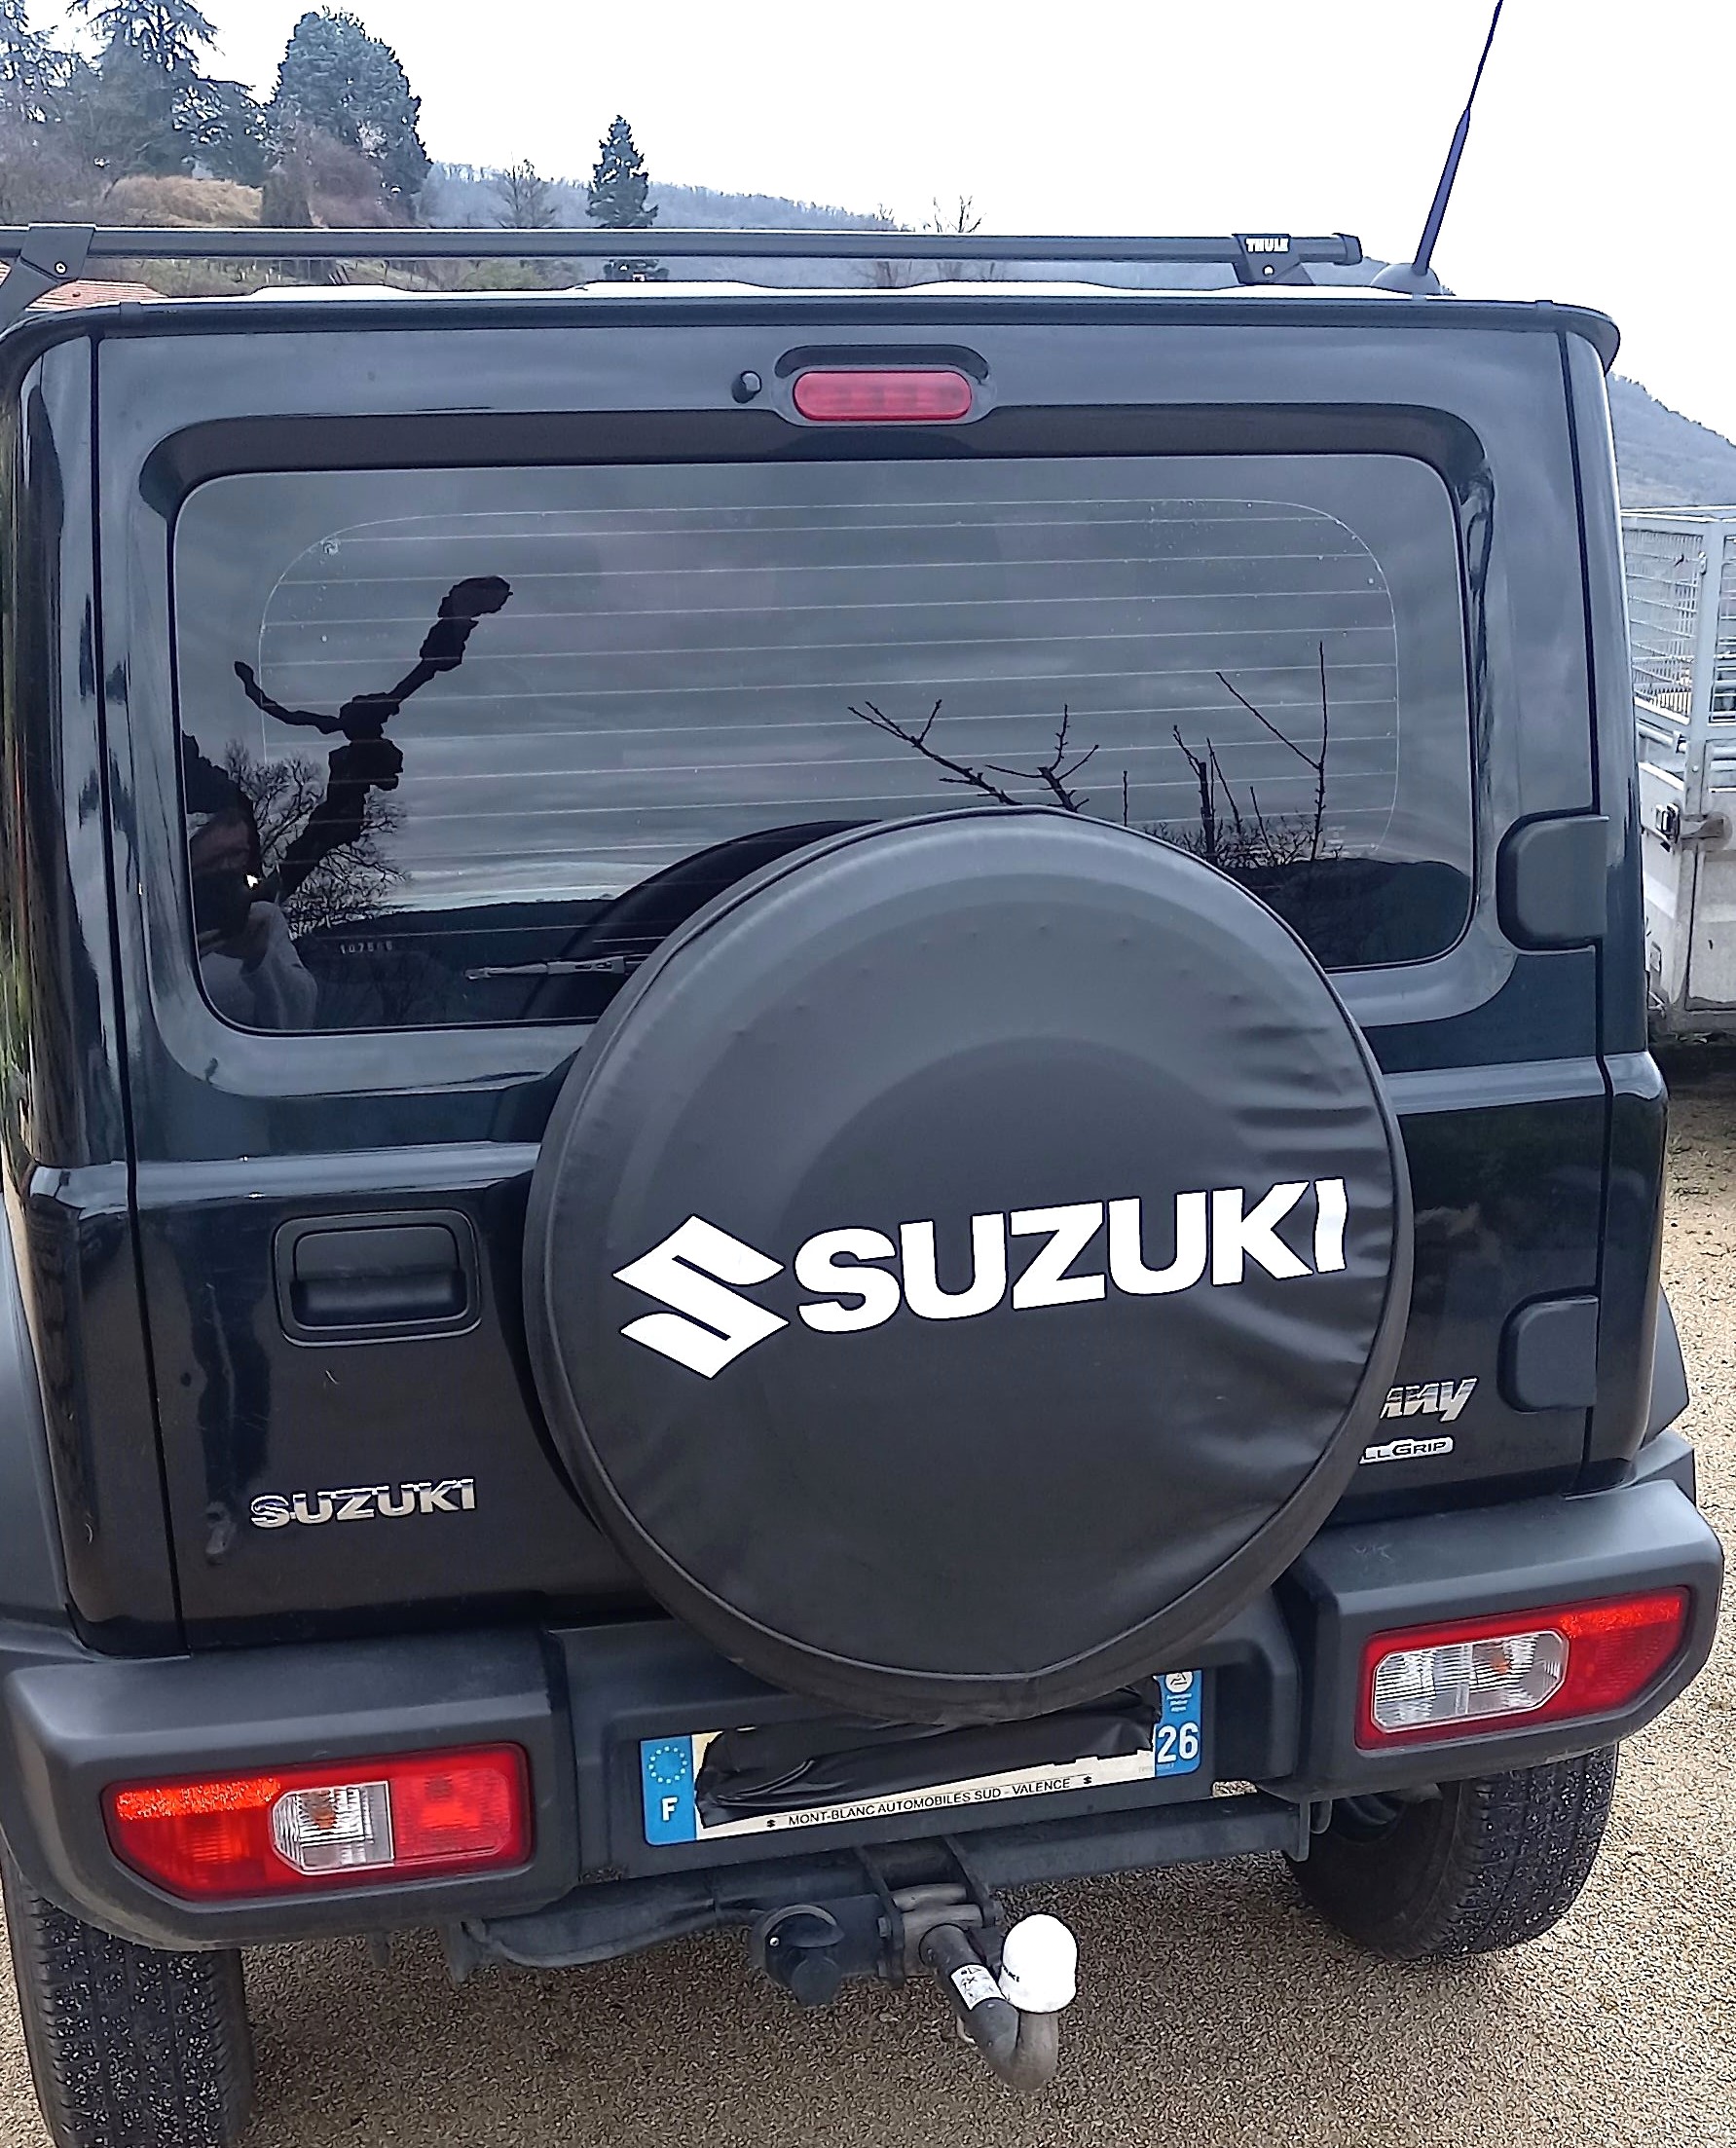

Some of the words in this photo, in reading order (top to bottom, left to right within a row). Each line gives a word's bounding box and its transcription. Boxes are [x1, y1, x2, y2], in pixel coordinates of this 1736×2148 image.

[1245, 238, 1289, 252] THULE
[794, 1177, 1347, 1334] SUZUKI
[250, 1478, 475, 1529] SUZUKI
[1157, 1722, 1199, 1763] 26
[661, 1796, 678, 1821] F
[788, 1804, 875, 1827] MONT-BLANC
[877, 1791, 972, 1814] AUTOMOBILES
[974, 1788, 1002, 1801] SUD
[1012, 1777, 1071, 1796] VALENCE
